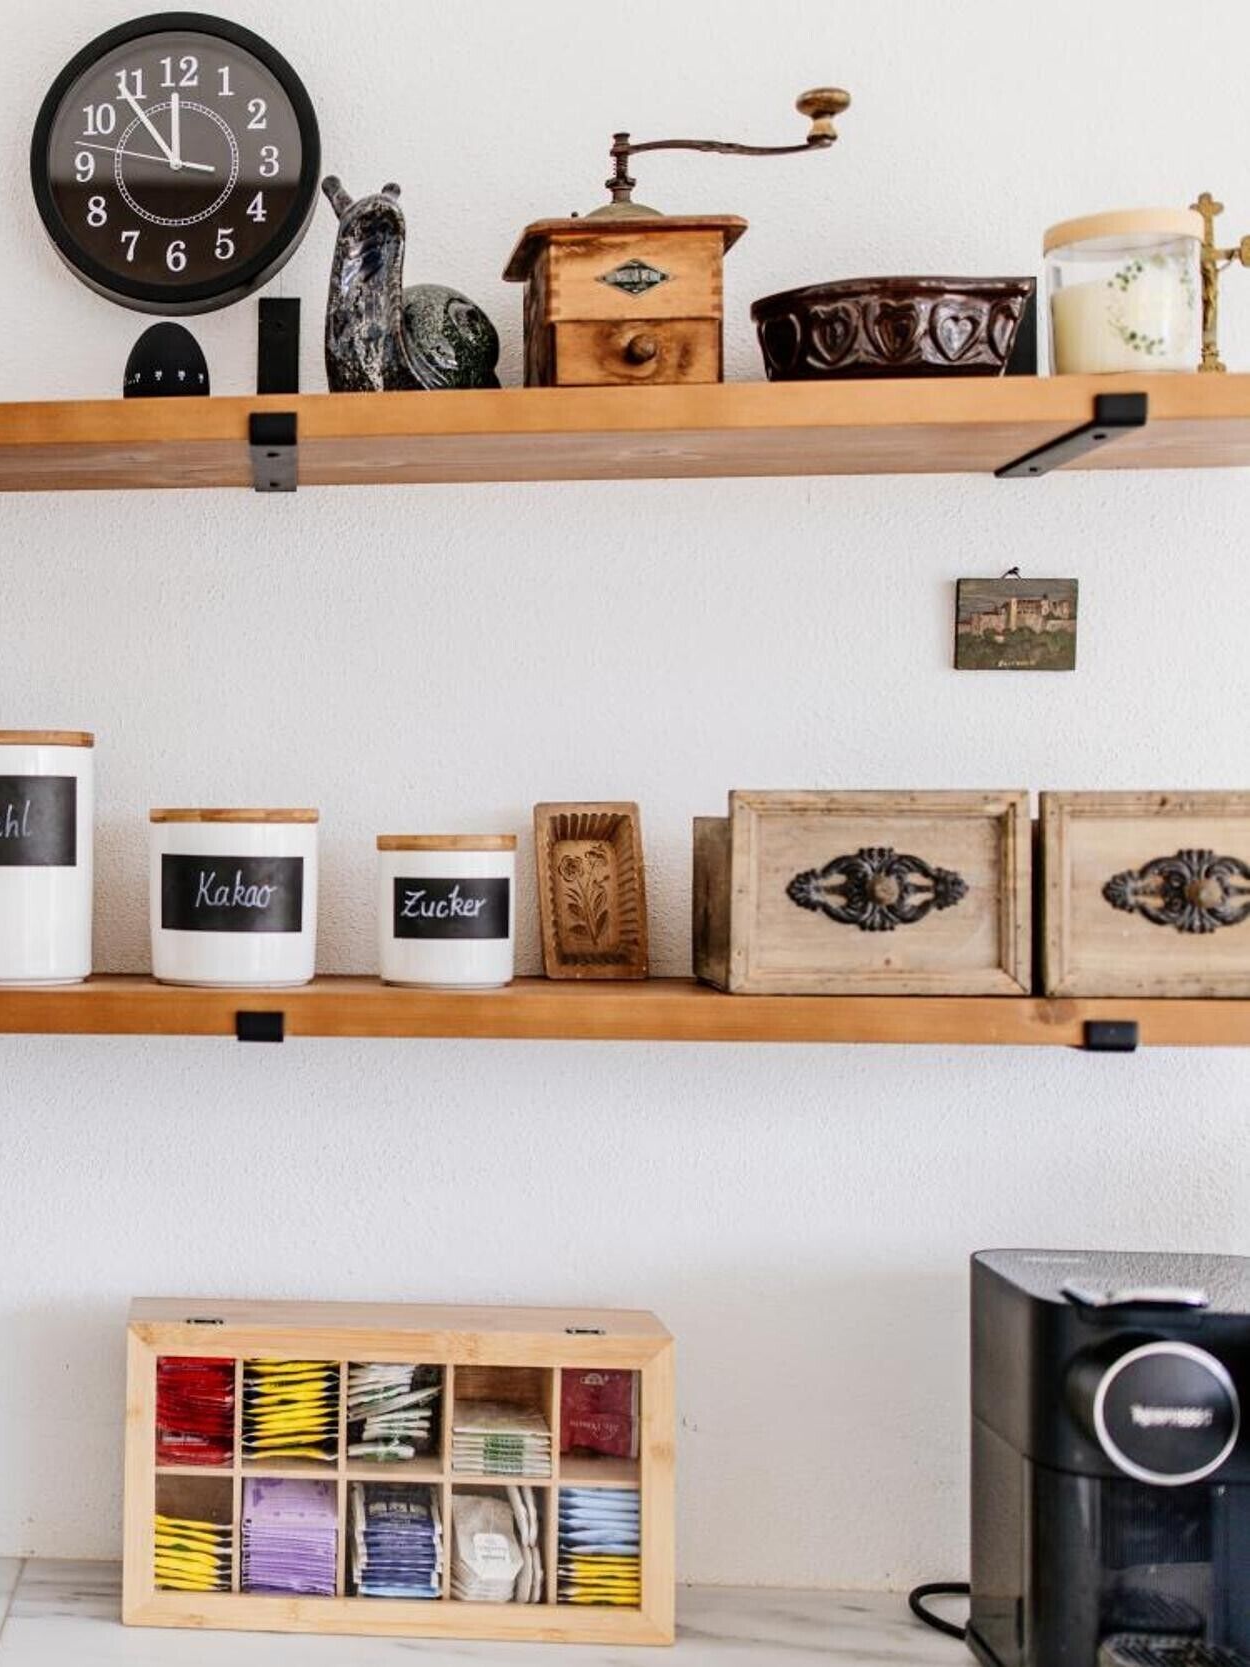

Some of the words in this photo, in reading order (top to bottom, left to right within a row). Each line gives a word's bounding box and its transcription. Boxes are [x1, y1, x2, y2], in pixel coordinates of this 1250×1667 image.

[115, 69, 147, 100] 11
[160, 56, 199, 88] 12
[217, 66, 235, 96] 1
[82, 104, 116, 136] 10
[247, 99, 268, 130] 2
[75, 152, 95, 183] 9
[259, 146, 280, 178] 3
[87, 196, 107, 227] 8
[246, 191, 268, 223] 4
[121, 230, 141, 262] 7
[166, 240, 187, 272] 6
[215, 227, 235, 260] 5
[194, 870, 276, 908] Kakao
[400, 884, 486, 918] Zucker
